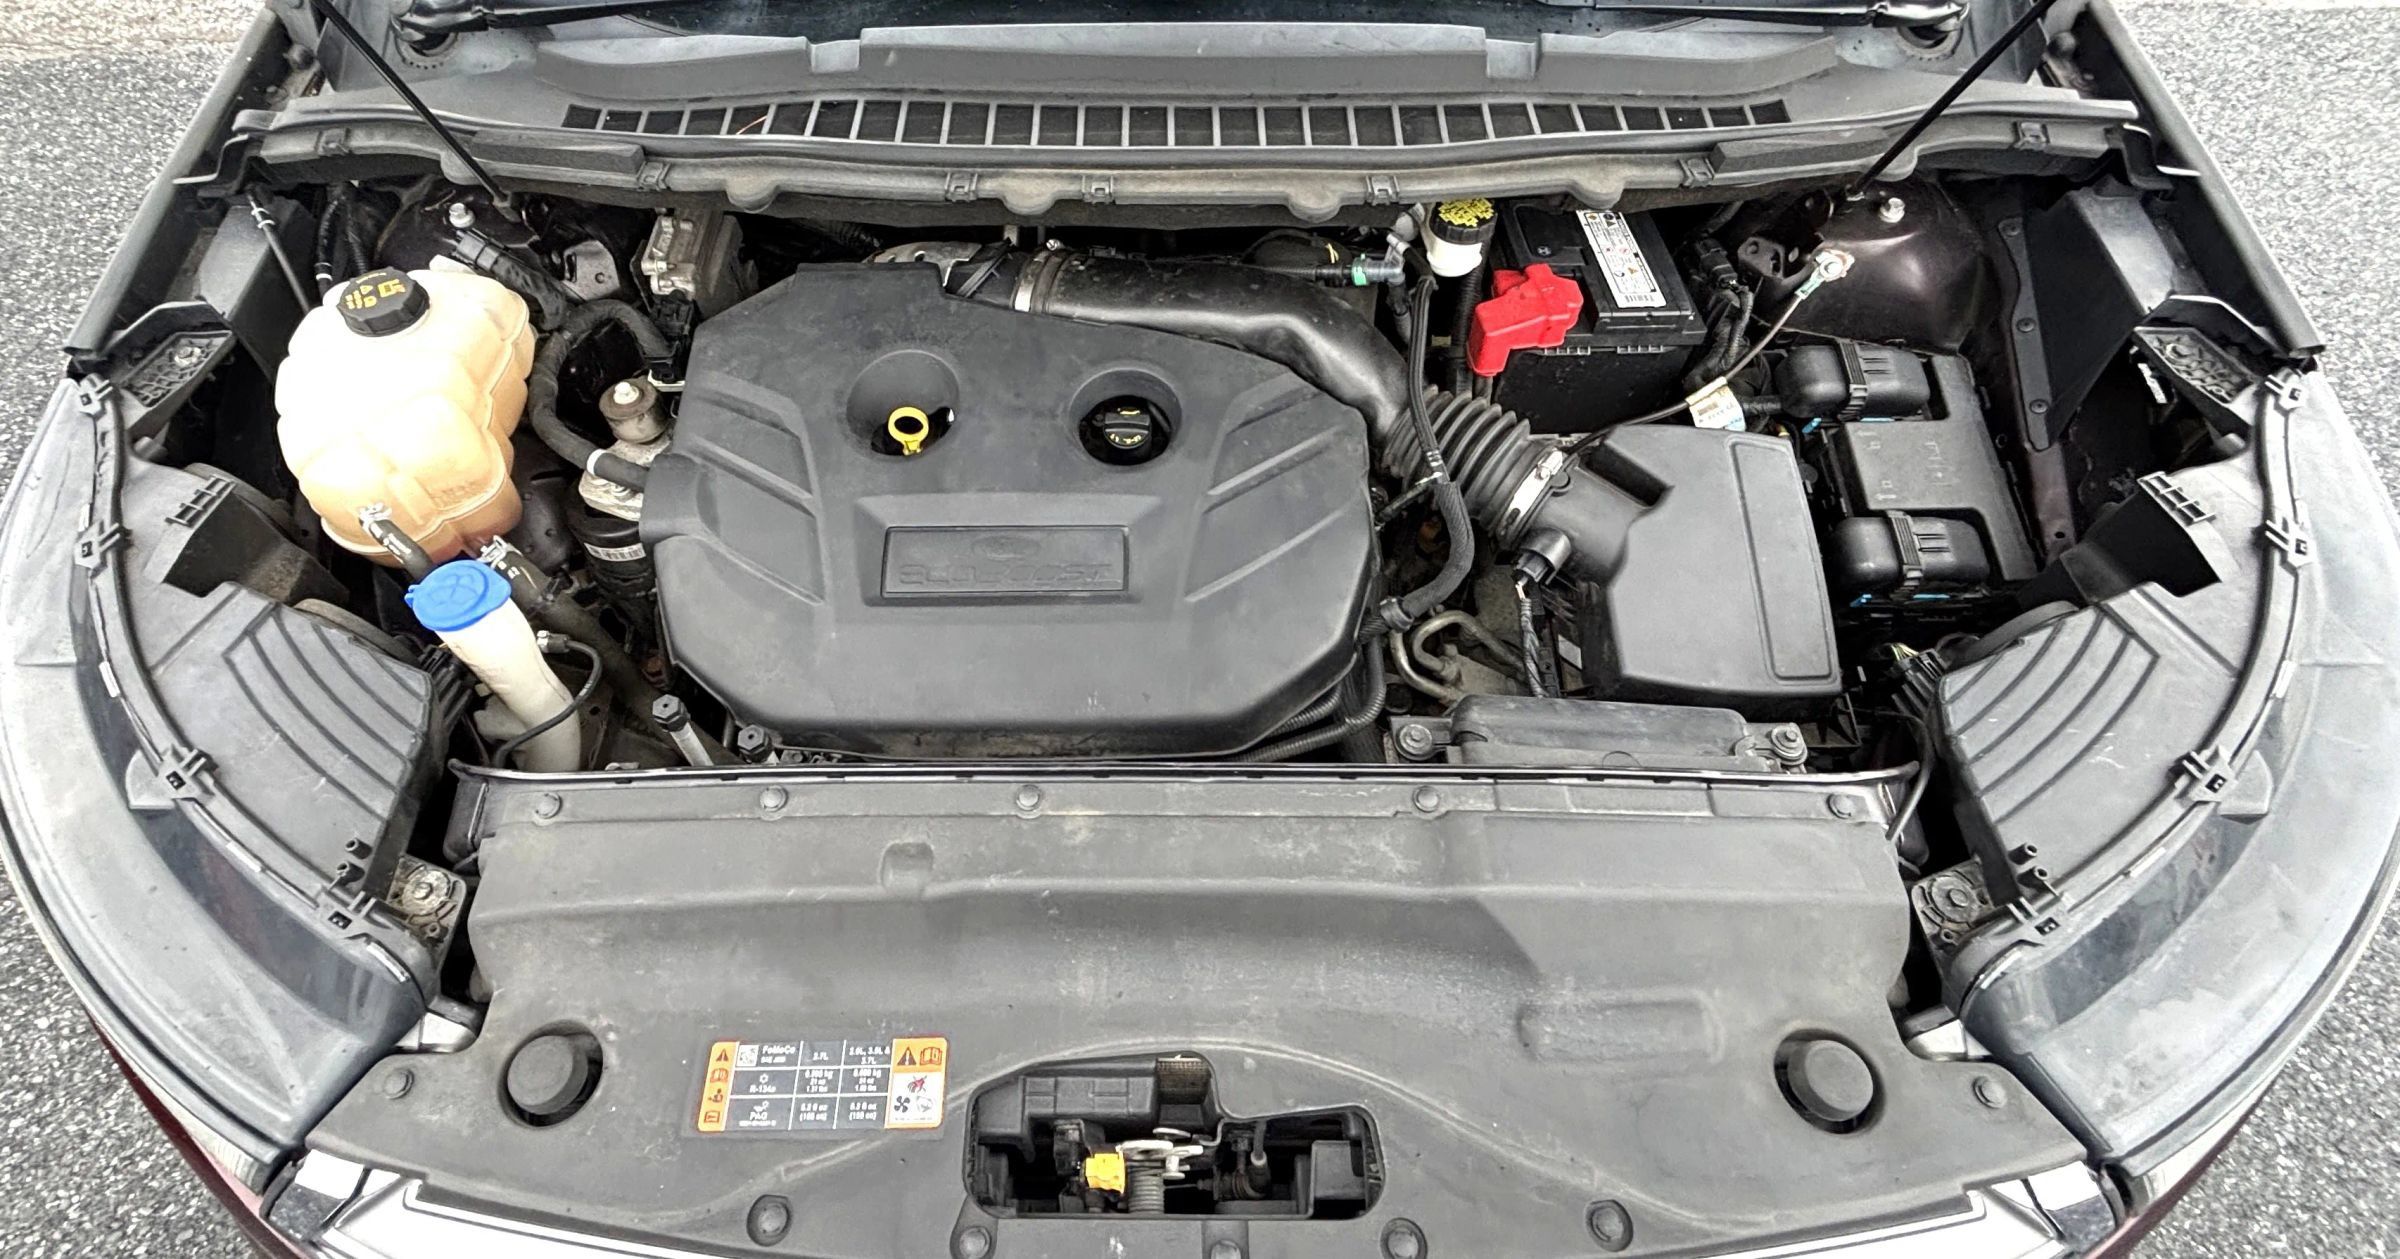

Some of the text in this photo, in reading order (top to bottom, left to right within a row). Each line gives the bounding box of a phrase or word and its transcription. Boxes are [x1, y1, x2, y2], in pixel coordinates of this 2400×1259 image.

[762, 1045, 796, 1054] FoMoCo
[749, 1084, 777, 1093] R-134a
[749, 1111, 768, 1120] PAG
